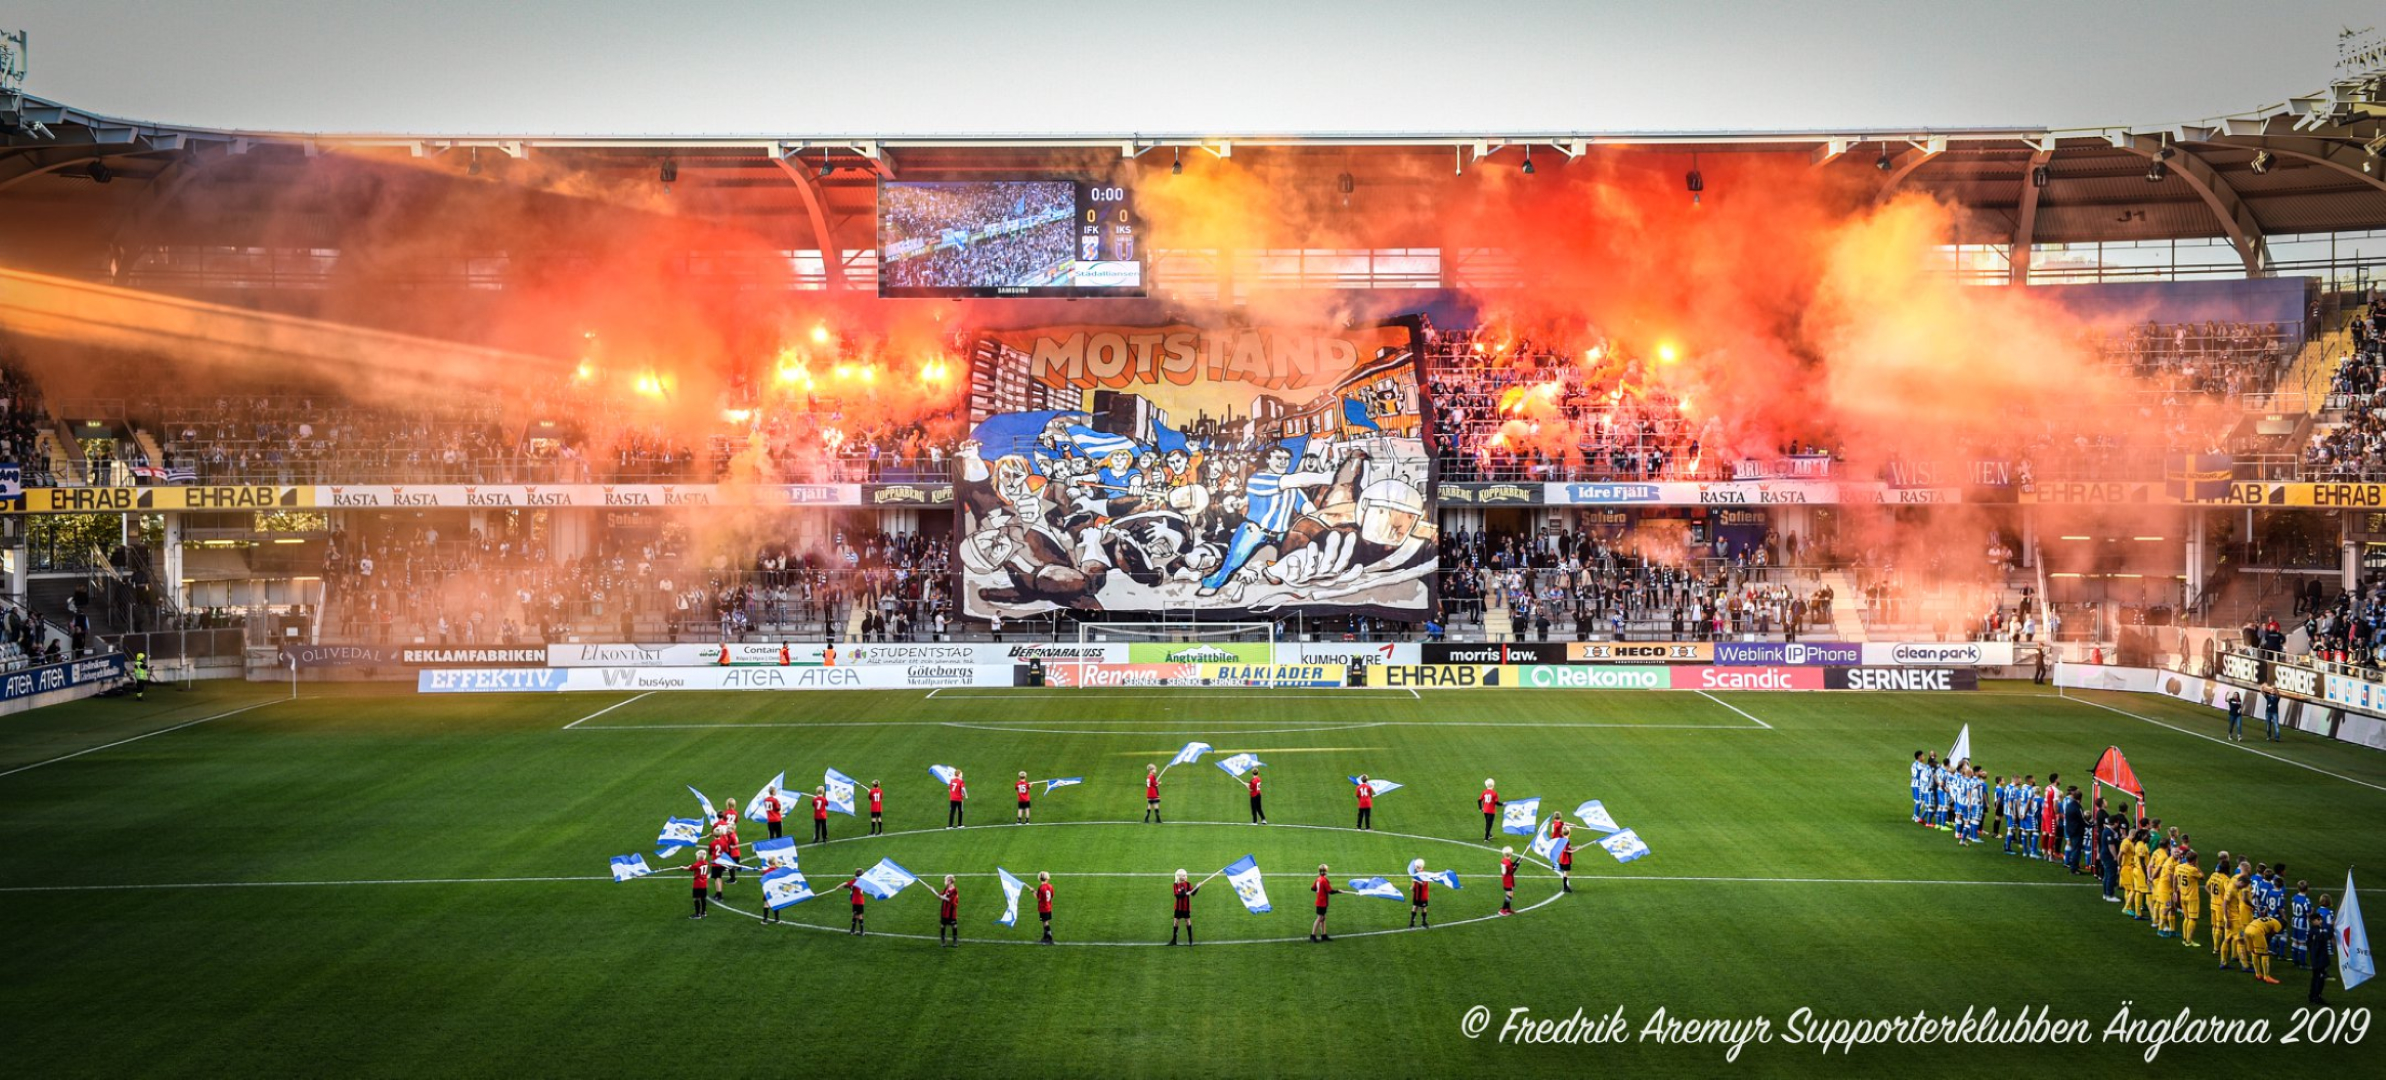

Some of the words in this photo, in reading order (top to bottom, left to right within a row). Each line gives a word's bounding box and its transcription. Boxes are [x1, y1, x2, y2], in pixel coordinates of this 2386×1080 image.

[1091, 187, 1124, 202] 0:00
[1087, 209, 1096, 223] 0
[1119, 209, 1128, 223] 0
[1083, 226, 1099, 234] IFK
[1116, 226, 1131, 234] IKS
[51, 489, 131, 509] EHRAB
[185, 487, 274, 506] EHRAB
[333, 494, 379, 505] RASTA
[394, 494, 438, 505] RASTA
[467, 494, 512, 505] RASTA
[527, 494, 572, 505] RASTA
[605, 493, 650, 505] RASTA
[664, 493, 709, 505] RASTA
[792, 488, 827, 501] Fjäll
[874, 487, 925, 503] KOPPARBERG
[1478, 486, 1530, 503] KOPPARBERG
[1579, 487, 1610, 498] Idre
[1613, 486, 1648, 500] Fjäll
[1700, 491, 1745, 503] RASTA
[1760, 491, 1806, 503] RASTA
[1900, 490, 1945, 503] RASTA
[2037, 484, 2125, 502] EHRAB
[2314, 486, 2381, 506] EHRAB
[1720, 509, 1765, 525] Sofiero
[302, 647, 382, 662] OLIVEDAL
[404, 650, 545, 662] REKLAMFABRIKEN
[601, 650, 662, 661] KONTAKT
[1166, 650, 1239, 663] Ångtvättbilen
[1450, 651, 1499, 662] morris
[1507, 650, 1537, 661] law.
[1615, 647, 1666, 656] HECO
[1718, 647, 1782, 661] Weblink
[1787, 648, 1803, 660] IP
[1807, 648, 1857, 661] Phone
[1896, 648, 1937, 659] clean
[1940, 648, 1977, 661] park
[1301, 655, 1348, 665] KUMHO
[907, 665, 973, 678] Göteborgs
[1083, 665, 1158, 685] Renova
[2222, 654, 2259, 683] SERNEKE
[1387, 666, 1475, 686] EHRAB
[1557, 668, 1658, 687] Rekomo
[1702, 668, 1792, 688] Scandic
[1847, 669, 1951, 690] SERNEKE
[2274, 665, 2317, 696] SERNEKE
[639, 678, 684, 688] bus4you
[950, 782, 957, 792] 7
[1017, 784, 1027, 793] 15
[1360, 787, 1368, 797] 14
[873, 792, 880, 802] 11
[1484, 793, 1493, 804] 10
[816, 800, 822, 810] 7
[715, 844, 721, 856] 2
[700, 865, 708, 875] 17
[2211, 882, 2219, 896] 16
[2260, 888, 2268, 901] 7
[2269, 896, 2276, 911] 8
[2292, 902, 2303, 917] 10
